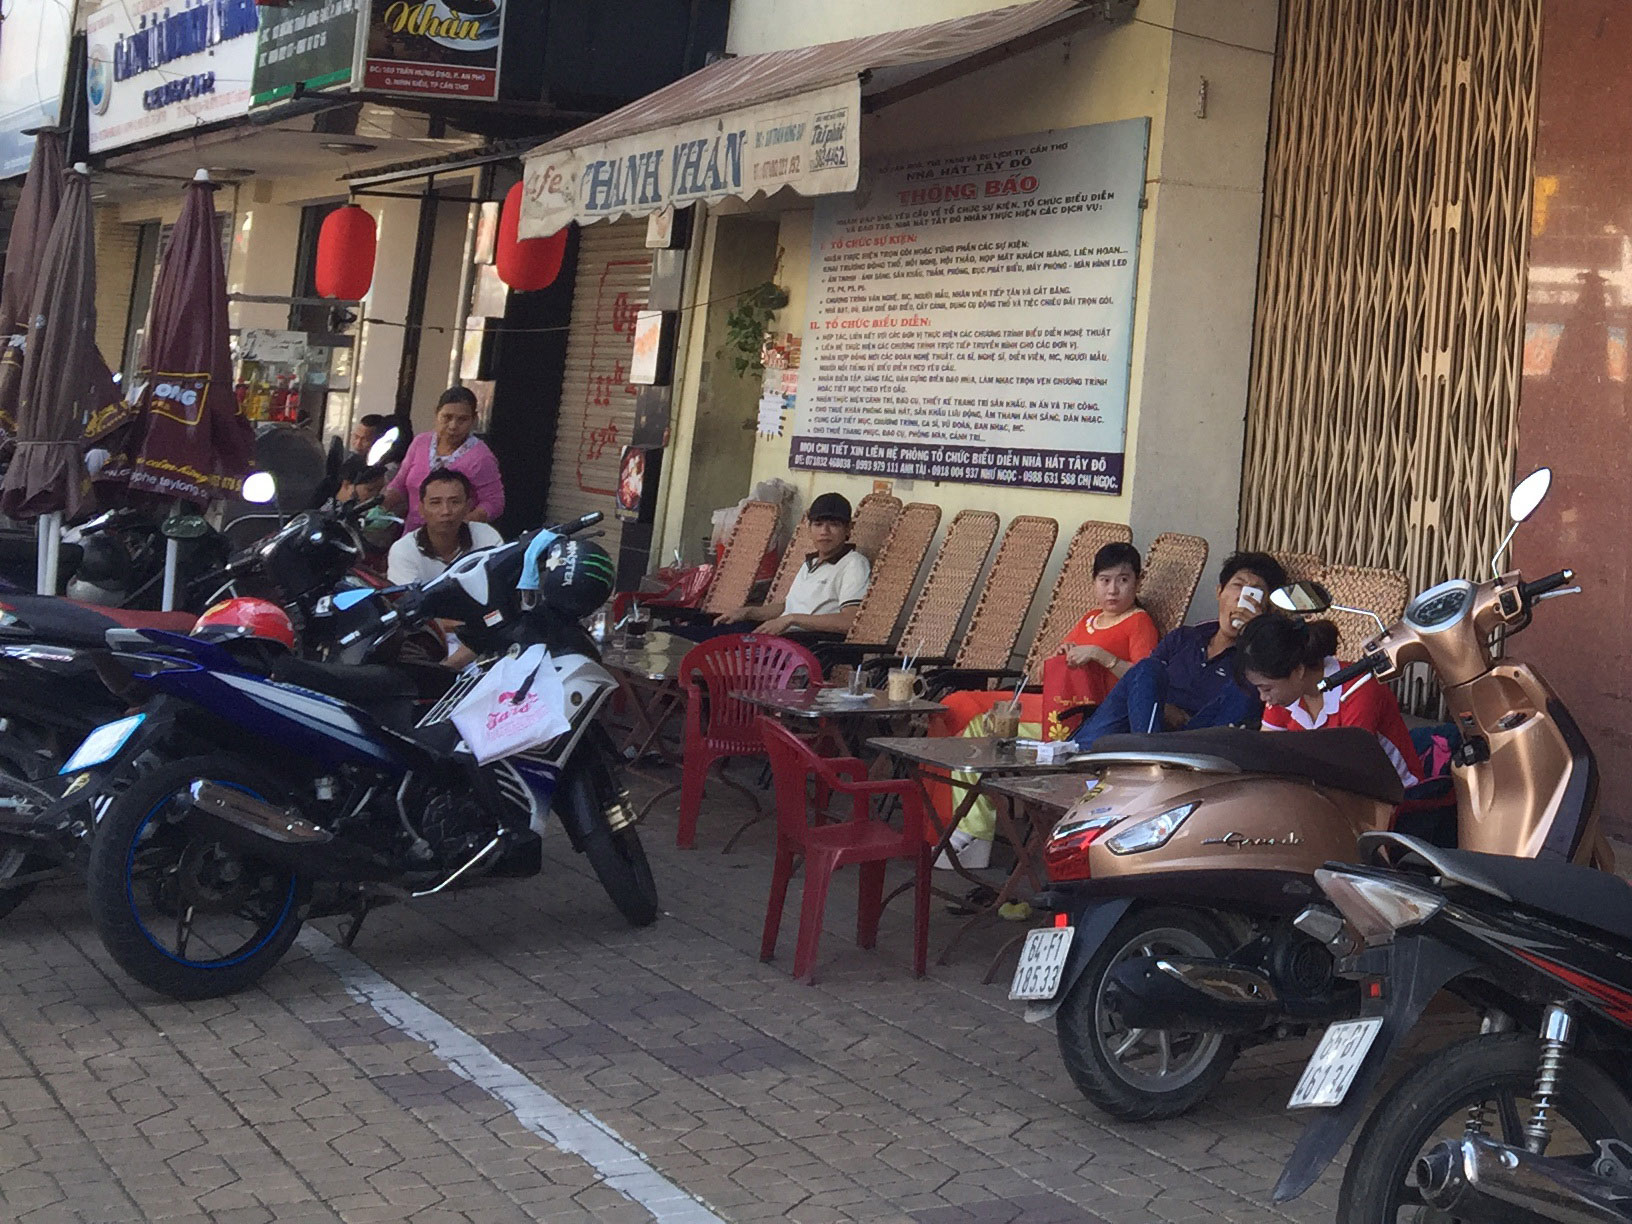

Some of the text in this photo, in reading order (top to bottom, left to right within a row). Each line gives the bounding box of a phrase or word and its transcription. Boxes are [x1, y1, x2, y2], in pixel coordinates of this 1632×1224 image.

[384, 1, 481, 41] Nhàn
[974, 159, 1004, 172] TÂY
[1009, 155, 1032, 168] ĐÔ
[896, 172, 1039, 206] THÔNG BÁO
[824, 316, 839, 329] TỔ
[840, 317, 870, 328] CHỨC
[830, 441, 848, 455] TIẾT
[849, 444, 864, 456] XIN
[899, 446, 929, 461] PHÒNG
[930, 446, 942, 462] TỔ
[944, 448, 970, 464] CHỨC
[971, 447, 995, 465] BIỂU
[995, 449, 1020, 467] DIỄN
[1020, 452, 1042, 469] NHÀ
[1044, 454, 1065, 470] HÁT
[1066, 455, 1089, 472] TÂY
[1090, 457, 1106, 473] ĐÔ
